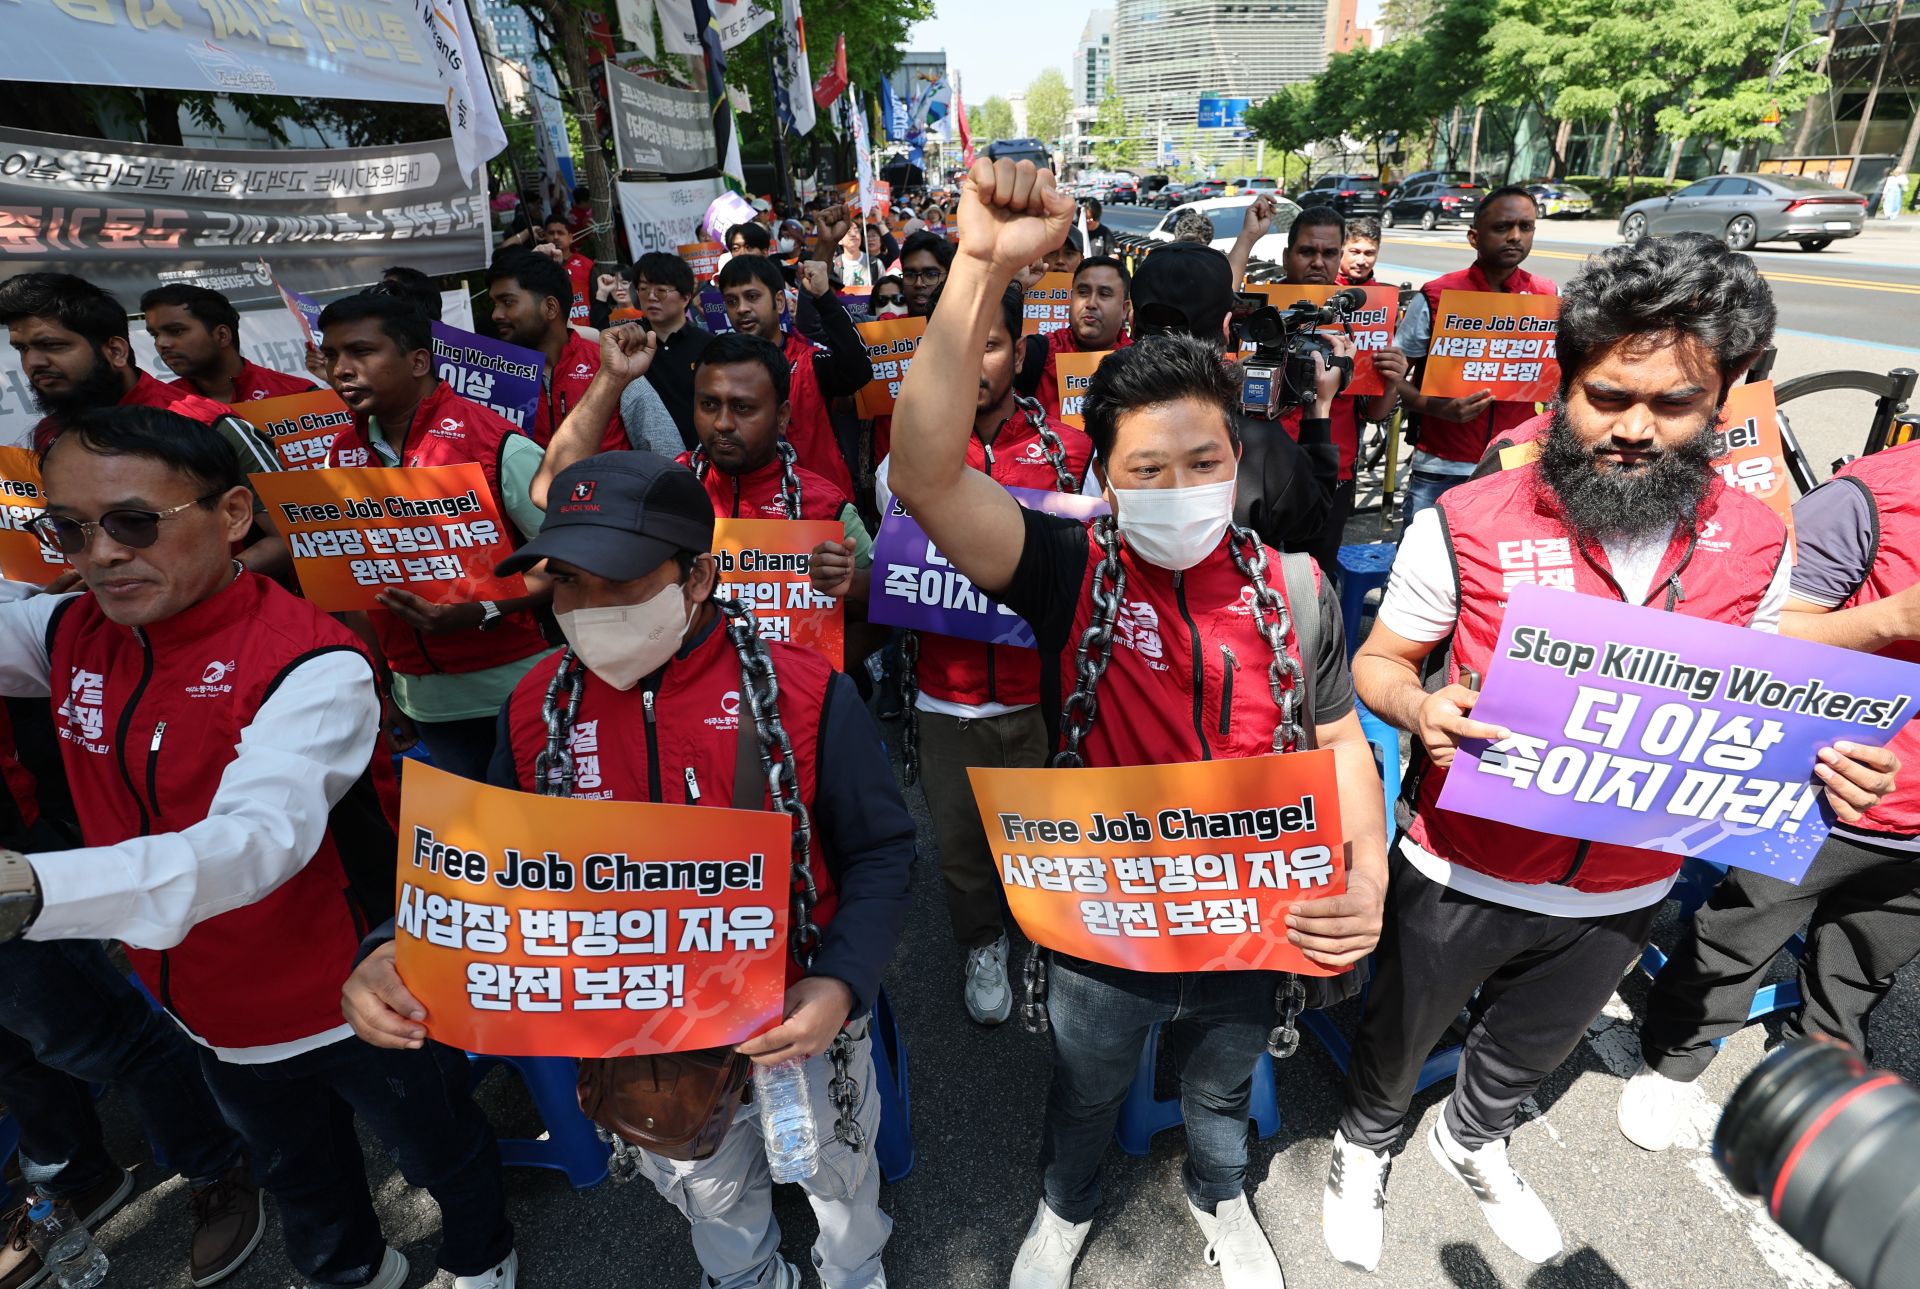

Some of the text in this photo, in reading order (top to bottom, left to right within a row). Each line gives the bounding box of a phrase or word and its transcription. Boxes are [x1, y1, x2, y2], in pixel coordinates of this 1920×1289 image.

[1048, 288, 1068, 300] Job
[1444, 314, 1483, 330] Free
[1485, 315, 1515, 332] Job
[465, 347, 539, 381] Workers!
[866, 340, 914, 357] ree Job
[1430, 336, 1543, 359] 사업장 변경의
[438, 362, 496, 400] 이상
[871, 360, 897, 380] 업장
[1462, 361, 1543, 382] 완전 보장!
[264, 419, 299, 438] Job
[278, 490, 482, 524] Free Job Change!
[289, 519, 500, 559] 사업장 변경의 자유
[1497, 537, 1574, 569] 단결
[350, 554, 466, 586] 완전 보장!
[712, 549, 811, 576] ob Chang
[1507, 626, 1911, 730] Stop Killing Workers!
[704, 716, 739, 725] 이주노동자
[1562, 685, 1786, 772] 더 이상
[571, 790, 614, 801] TRUGGLE!
[1476, 732, 1824, 835] 죽이지 마라!
[998, 794, 1316, 844] Free Job Change!
[412, 824, 765, 896] Free Job Change!
[1002, 844, 1335, 895] 사업장 변경의 자유
[396, 882, 775, 957] 사업장 변경의 자유
[1080, 897, 1262, 938] 완전 보장!
[465, 962, 686, 1012] 완전 보장!
